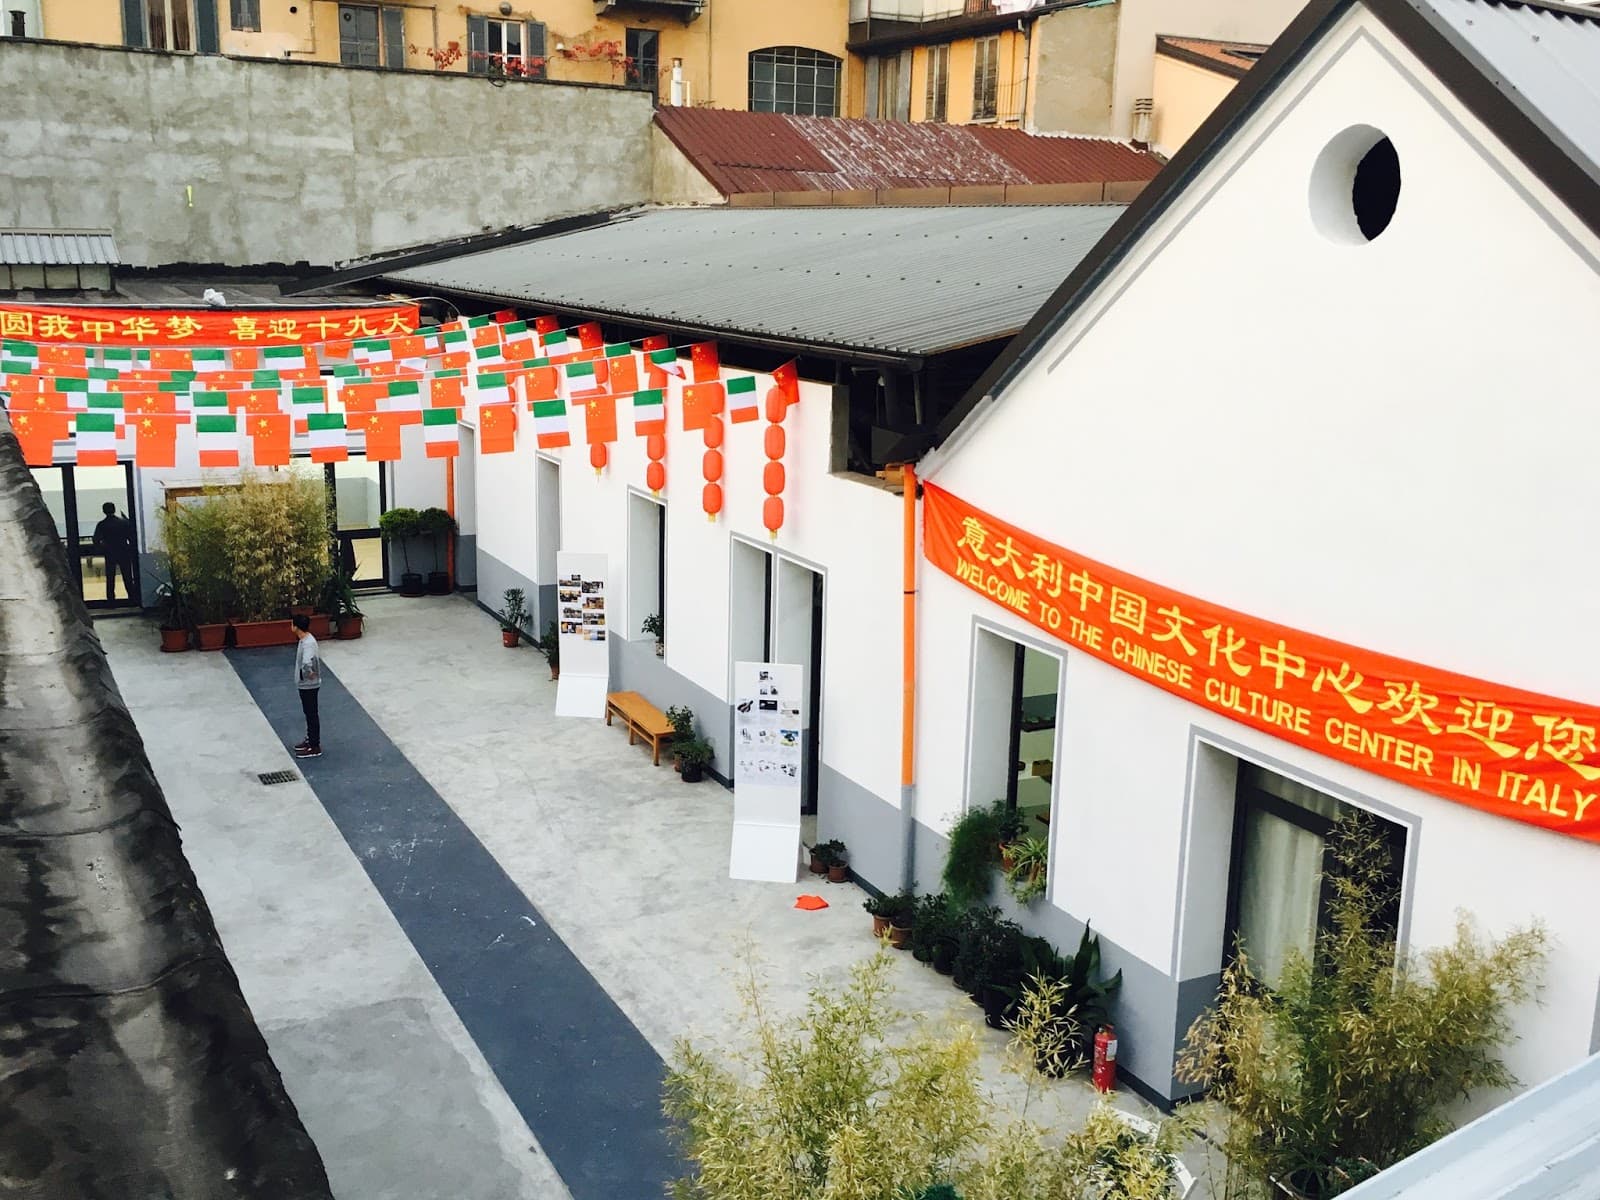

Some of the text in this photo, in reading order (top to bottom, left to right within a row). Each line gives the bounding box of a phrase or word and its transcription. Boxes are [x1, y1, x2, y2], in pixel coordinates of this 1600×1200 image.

[0, 310, 414, 342] 圆我中华梦 喜迎十九大
[955, 556, 1598, 822] WELCOME TO THE CHINESE CULTURE CENTER IN ITALY
[956, 516, 1600, 781] 意大利中国文化中心欢迎您
